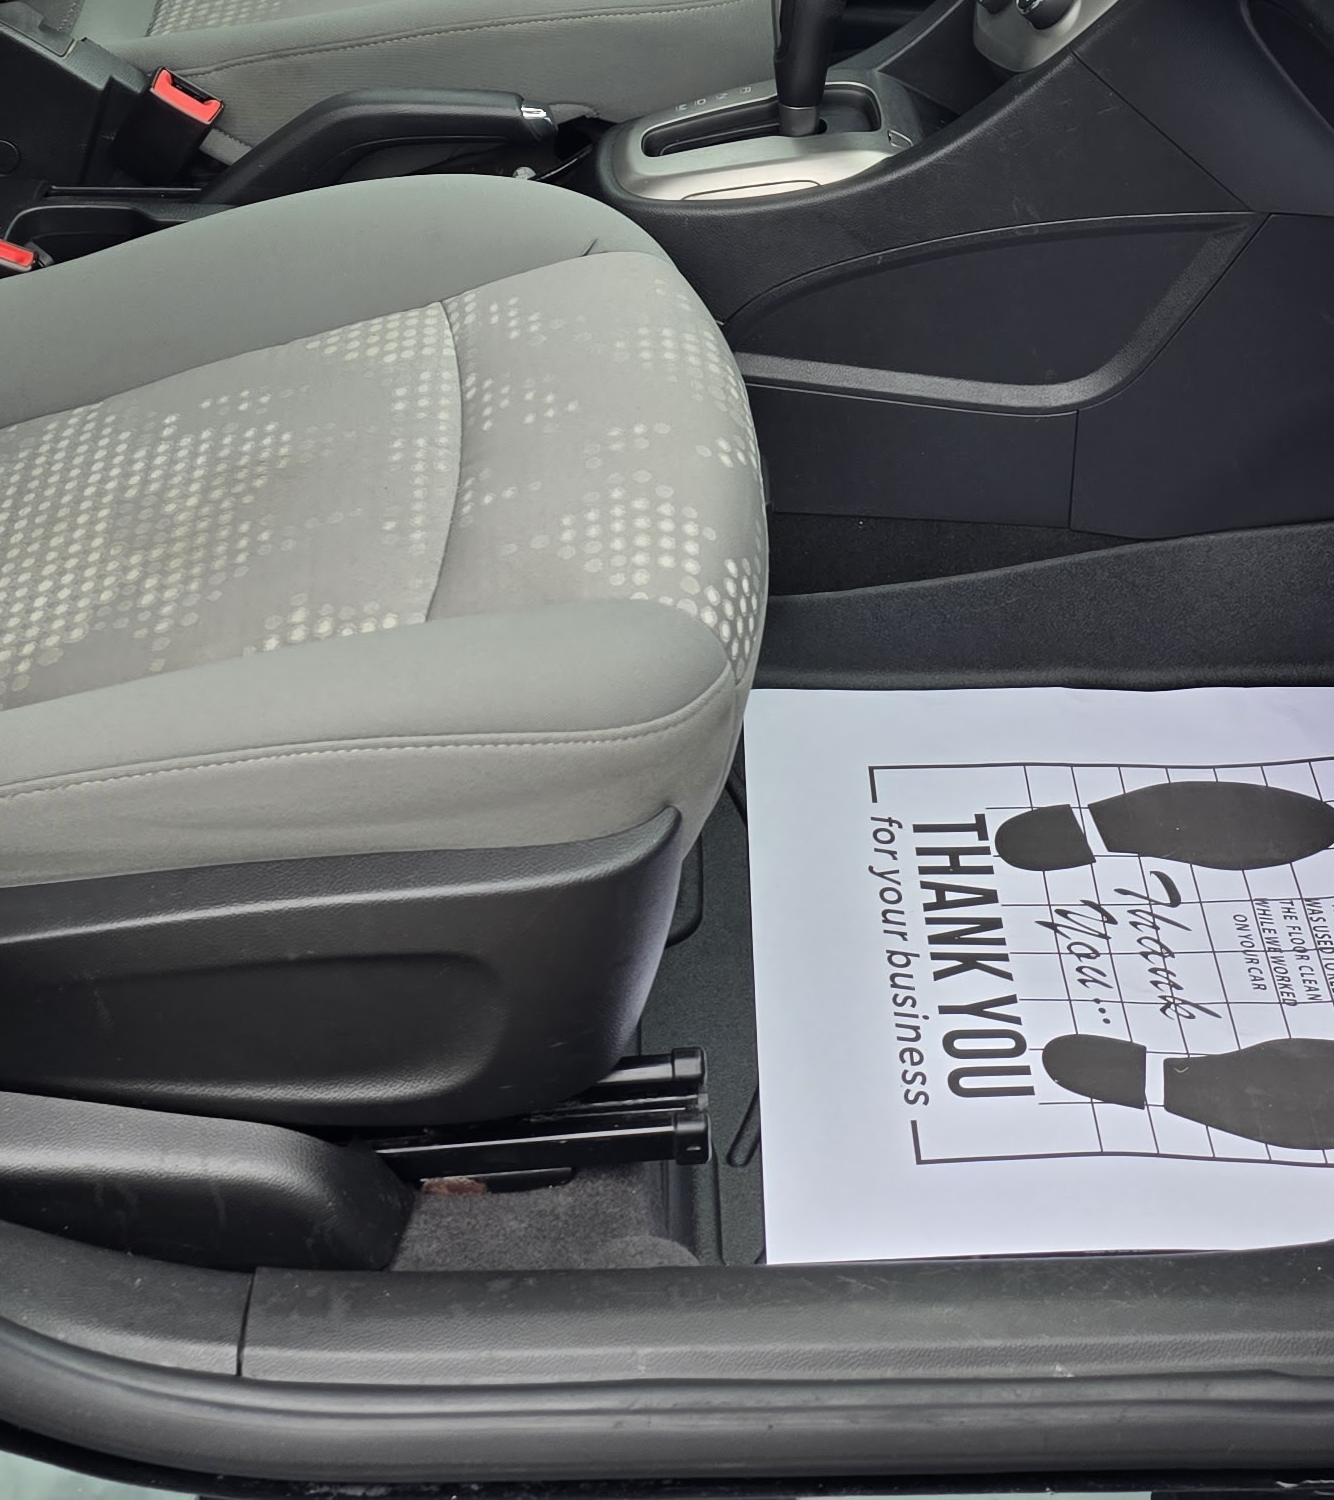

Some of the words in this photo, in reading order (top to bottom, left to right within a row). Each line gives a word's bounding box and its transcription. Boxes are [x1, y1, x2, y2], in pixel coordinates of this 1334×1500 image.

[870, 815, 903, 861] for
[868, 865, 909, 942] your
[912, 813, 1015, 982] THANK
[1278, 899, 1299, 921] THE
[1304, 898, 1327, 923] WAS
[1232, 913, 1251, 932] ON
[1252, 898, 1277, 935] WHILE
[1113, 870, 1223, 1021] Thank
[1237, 933, 1260, 965] YOUR
[1264, 936, 1283, 954] WE
[1286, 925, 1311, 961] FLOOR
[1247, 966, 1267, 991] CAR
[1269, 955, 1299, 1007] WORKED
[1298, 965, 1324, 1002] CLEAN
[885, 948, 931, 1107] business
[937, 993, 1036, 1099] YOU
